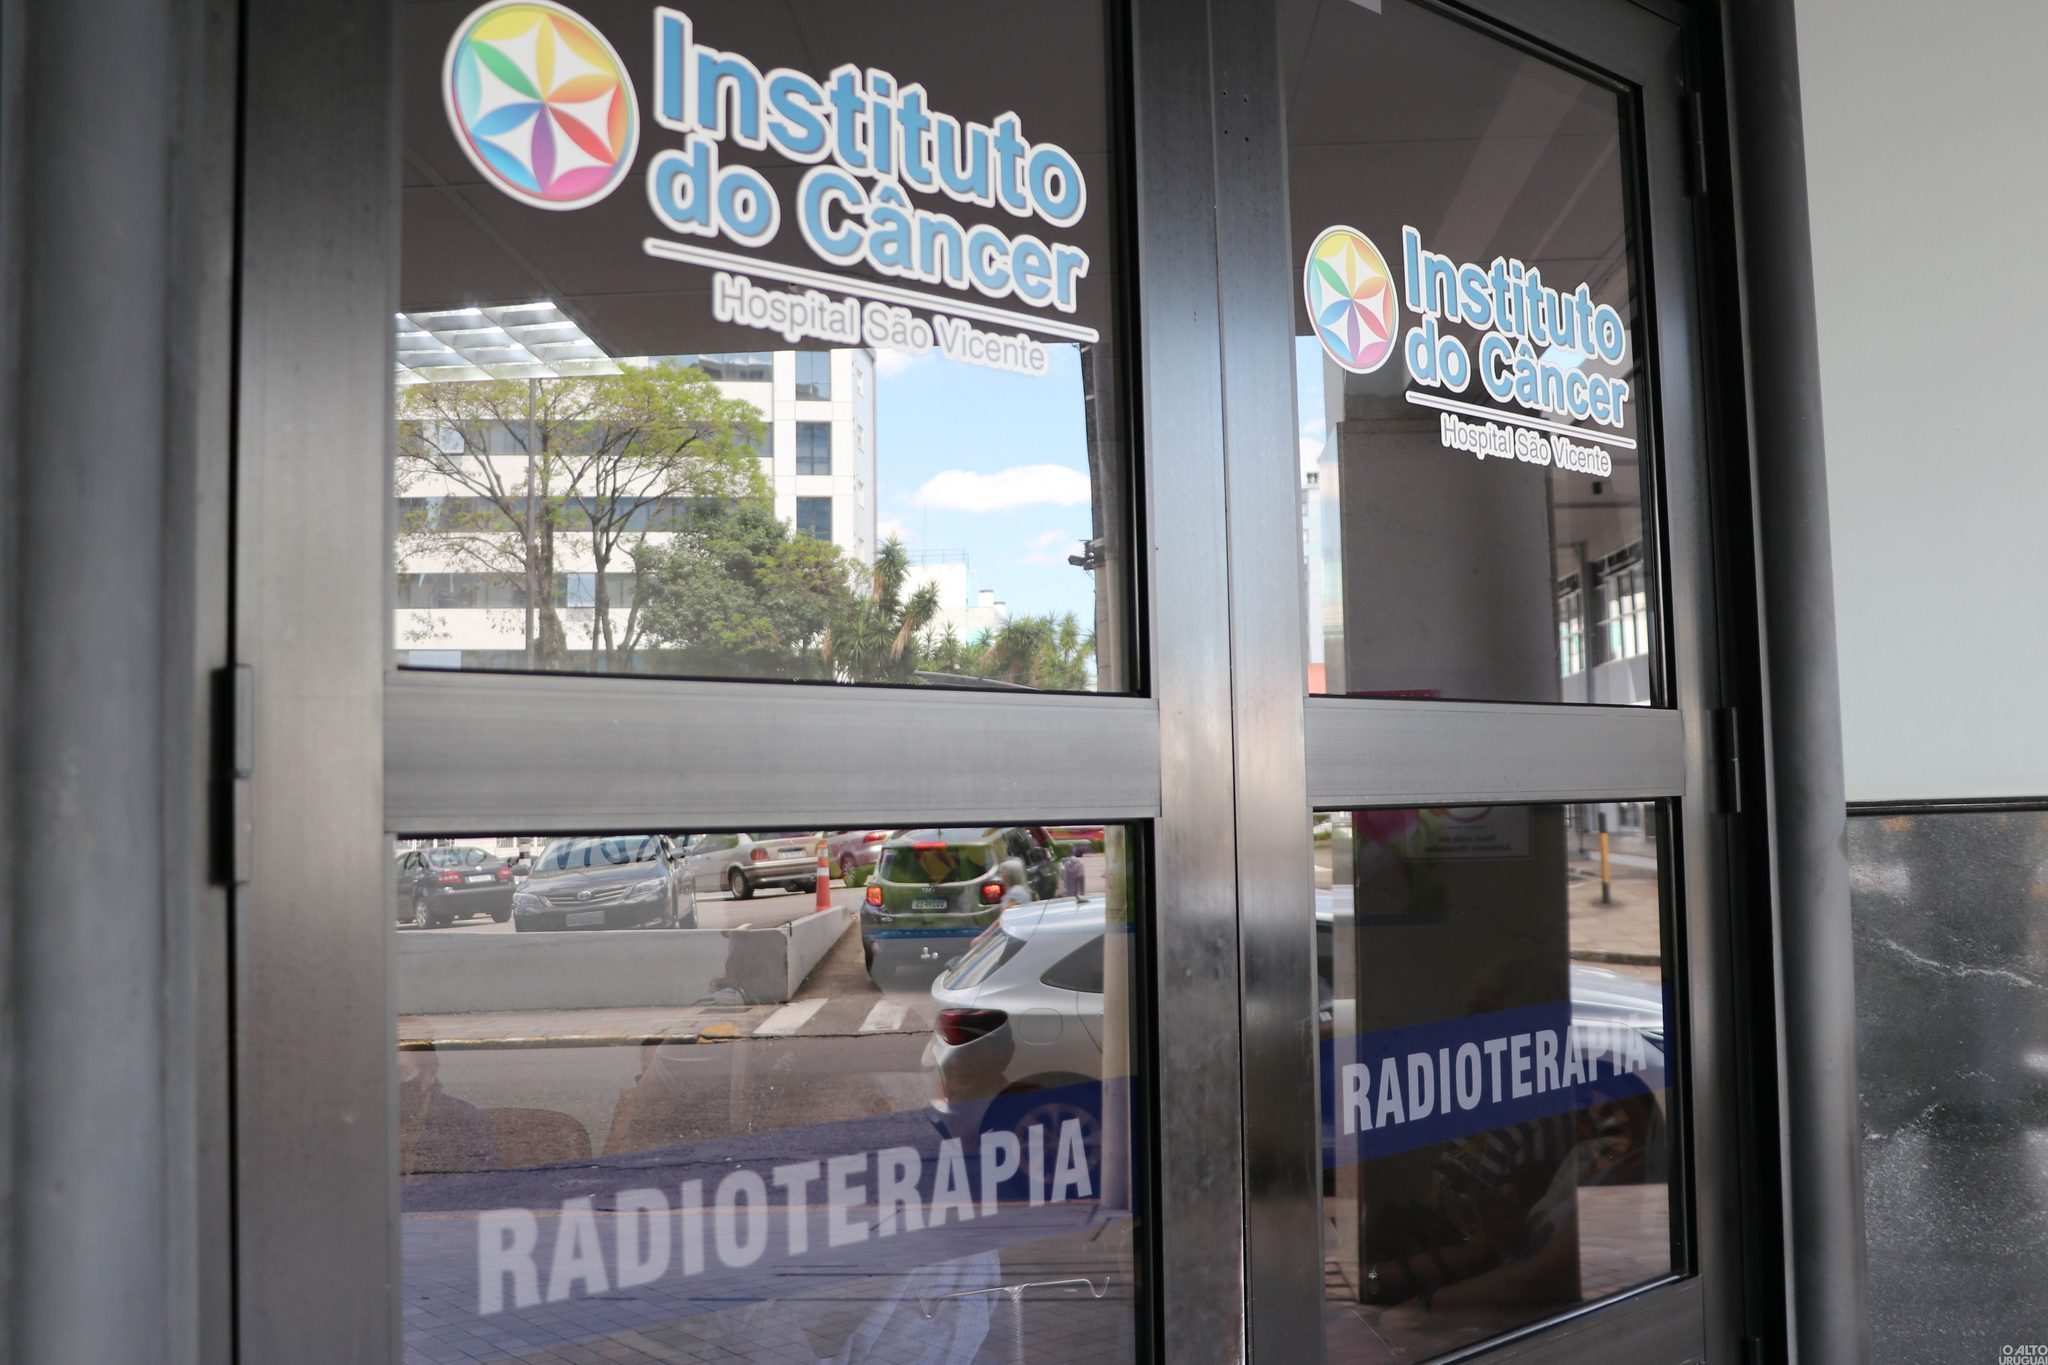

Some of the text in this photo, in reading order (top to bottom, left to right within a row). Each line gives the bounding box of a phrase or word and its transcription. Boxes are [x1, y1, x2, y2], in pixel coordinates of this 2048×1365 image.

[653, 7, 1086, 227] Instituto
[648, 133, 1088, 312] do Câncer
[714, 273, 1049, 375] Hospital São Vicente
[1402, 225, 1625, 365] Instituto
[1405, 314, 1628, 427] do Câncer
[1440, 412, 1611, 477] Hospital São Vicente
[1342, 1012, 1647, 1135] RADIOTERAPIA
[479, 1117, 1093, 1316] RADIOTERAPIA
